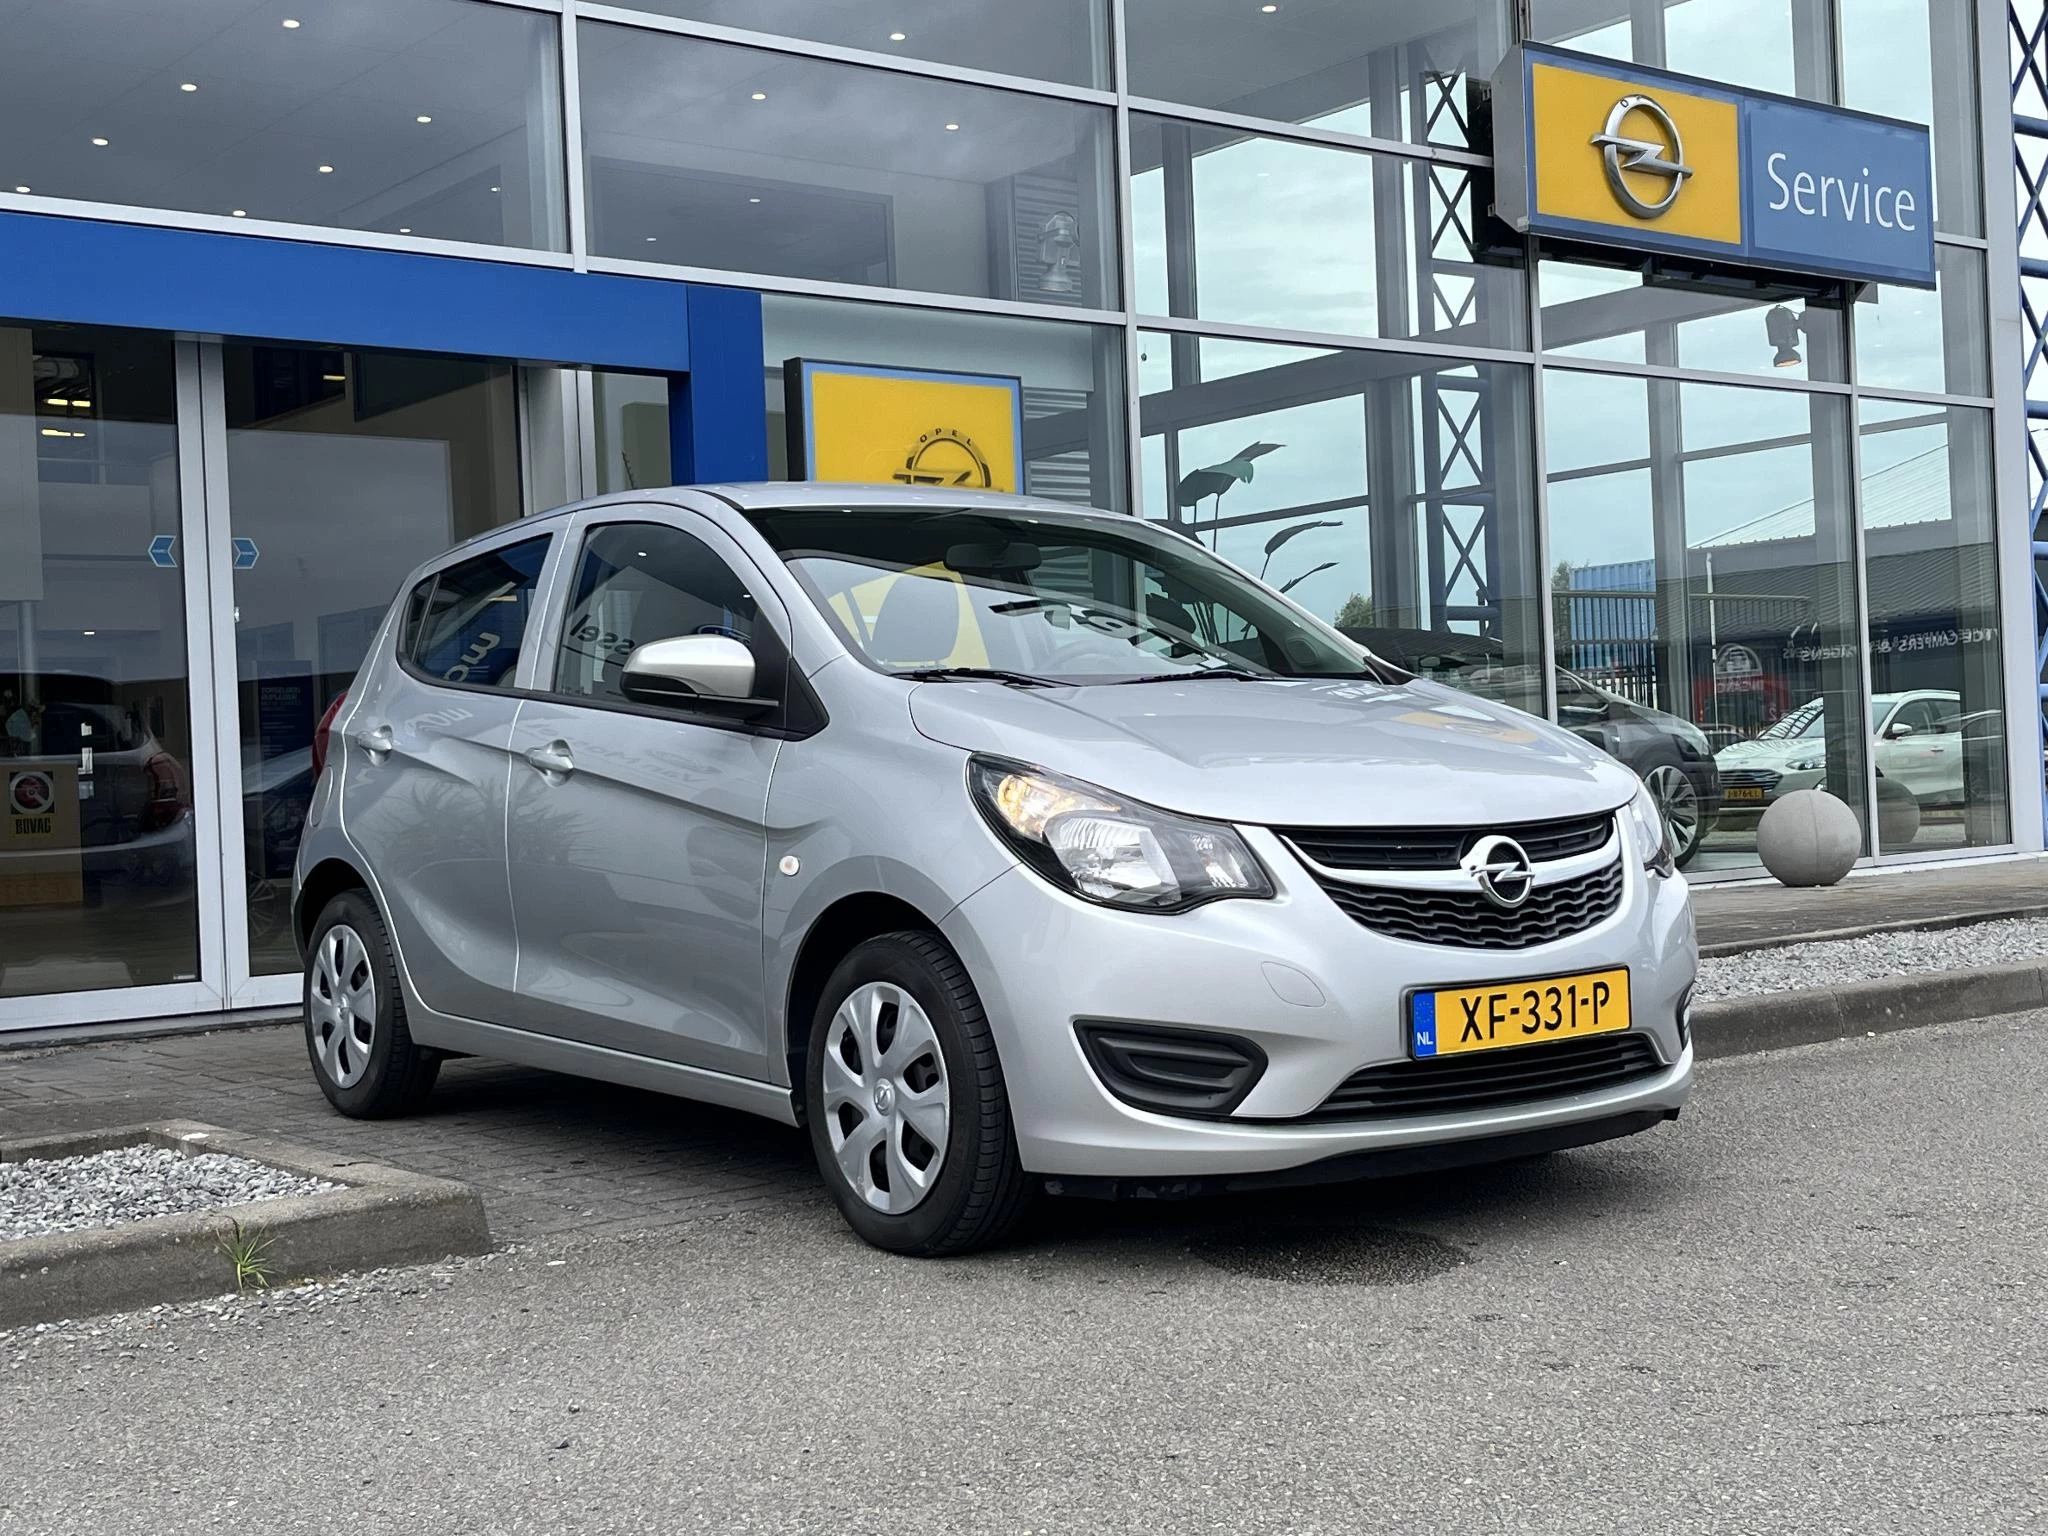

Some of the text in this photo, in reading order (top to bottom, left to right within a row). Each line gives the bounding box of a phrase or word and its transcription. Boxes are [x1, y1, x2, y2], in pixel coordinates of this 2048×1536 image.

[1767, 152, 1916, 231] Service
[920, 427, 972, 446] OPEL
[1459, 981, 1610, 1043] XF-331-P
[1416, 1031, 1434, 1047] NL
